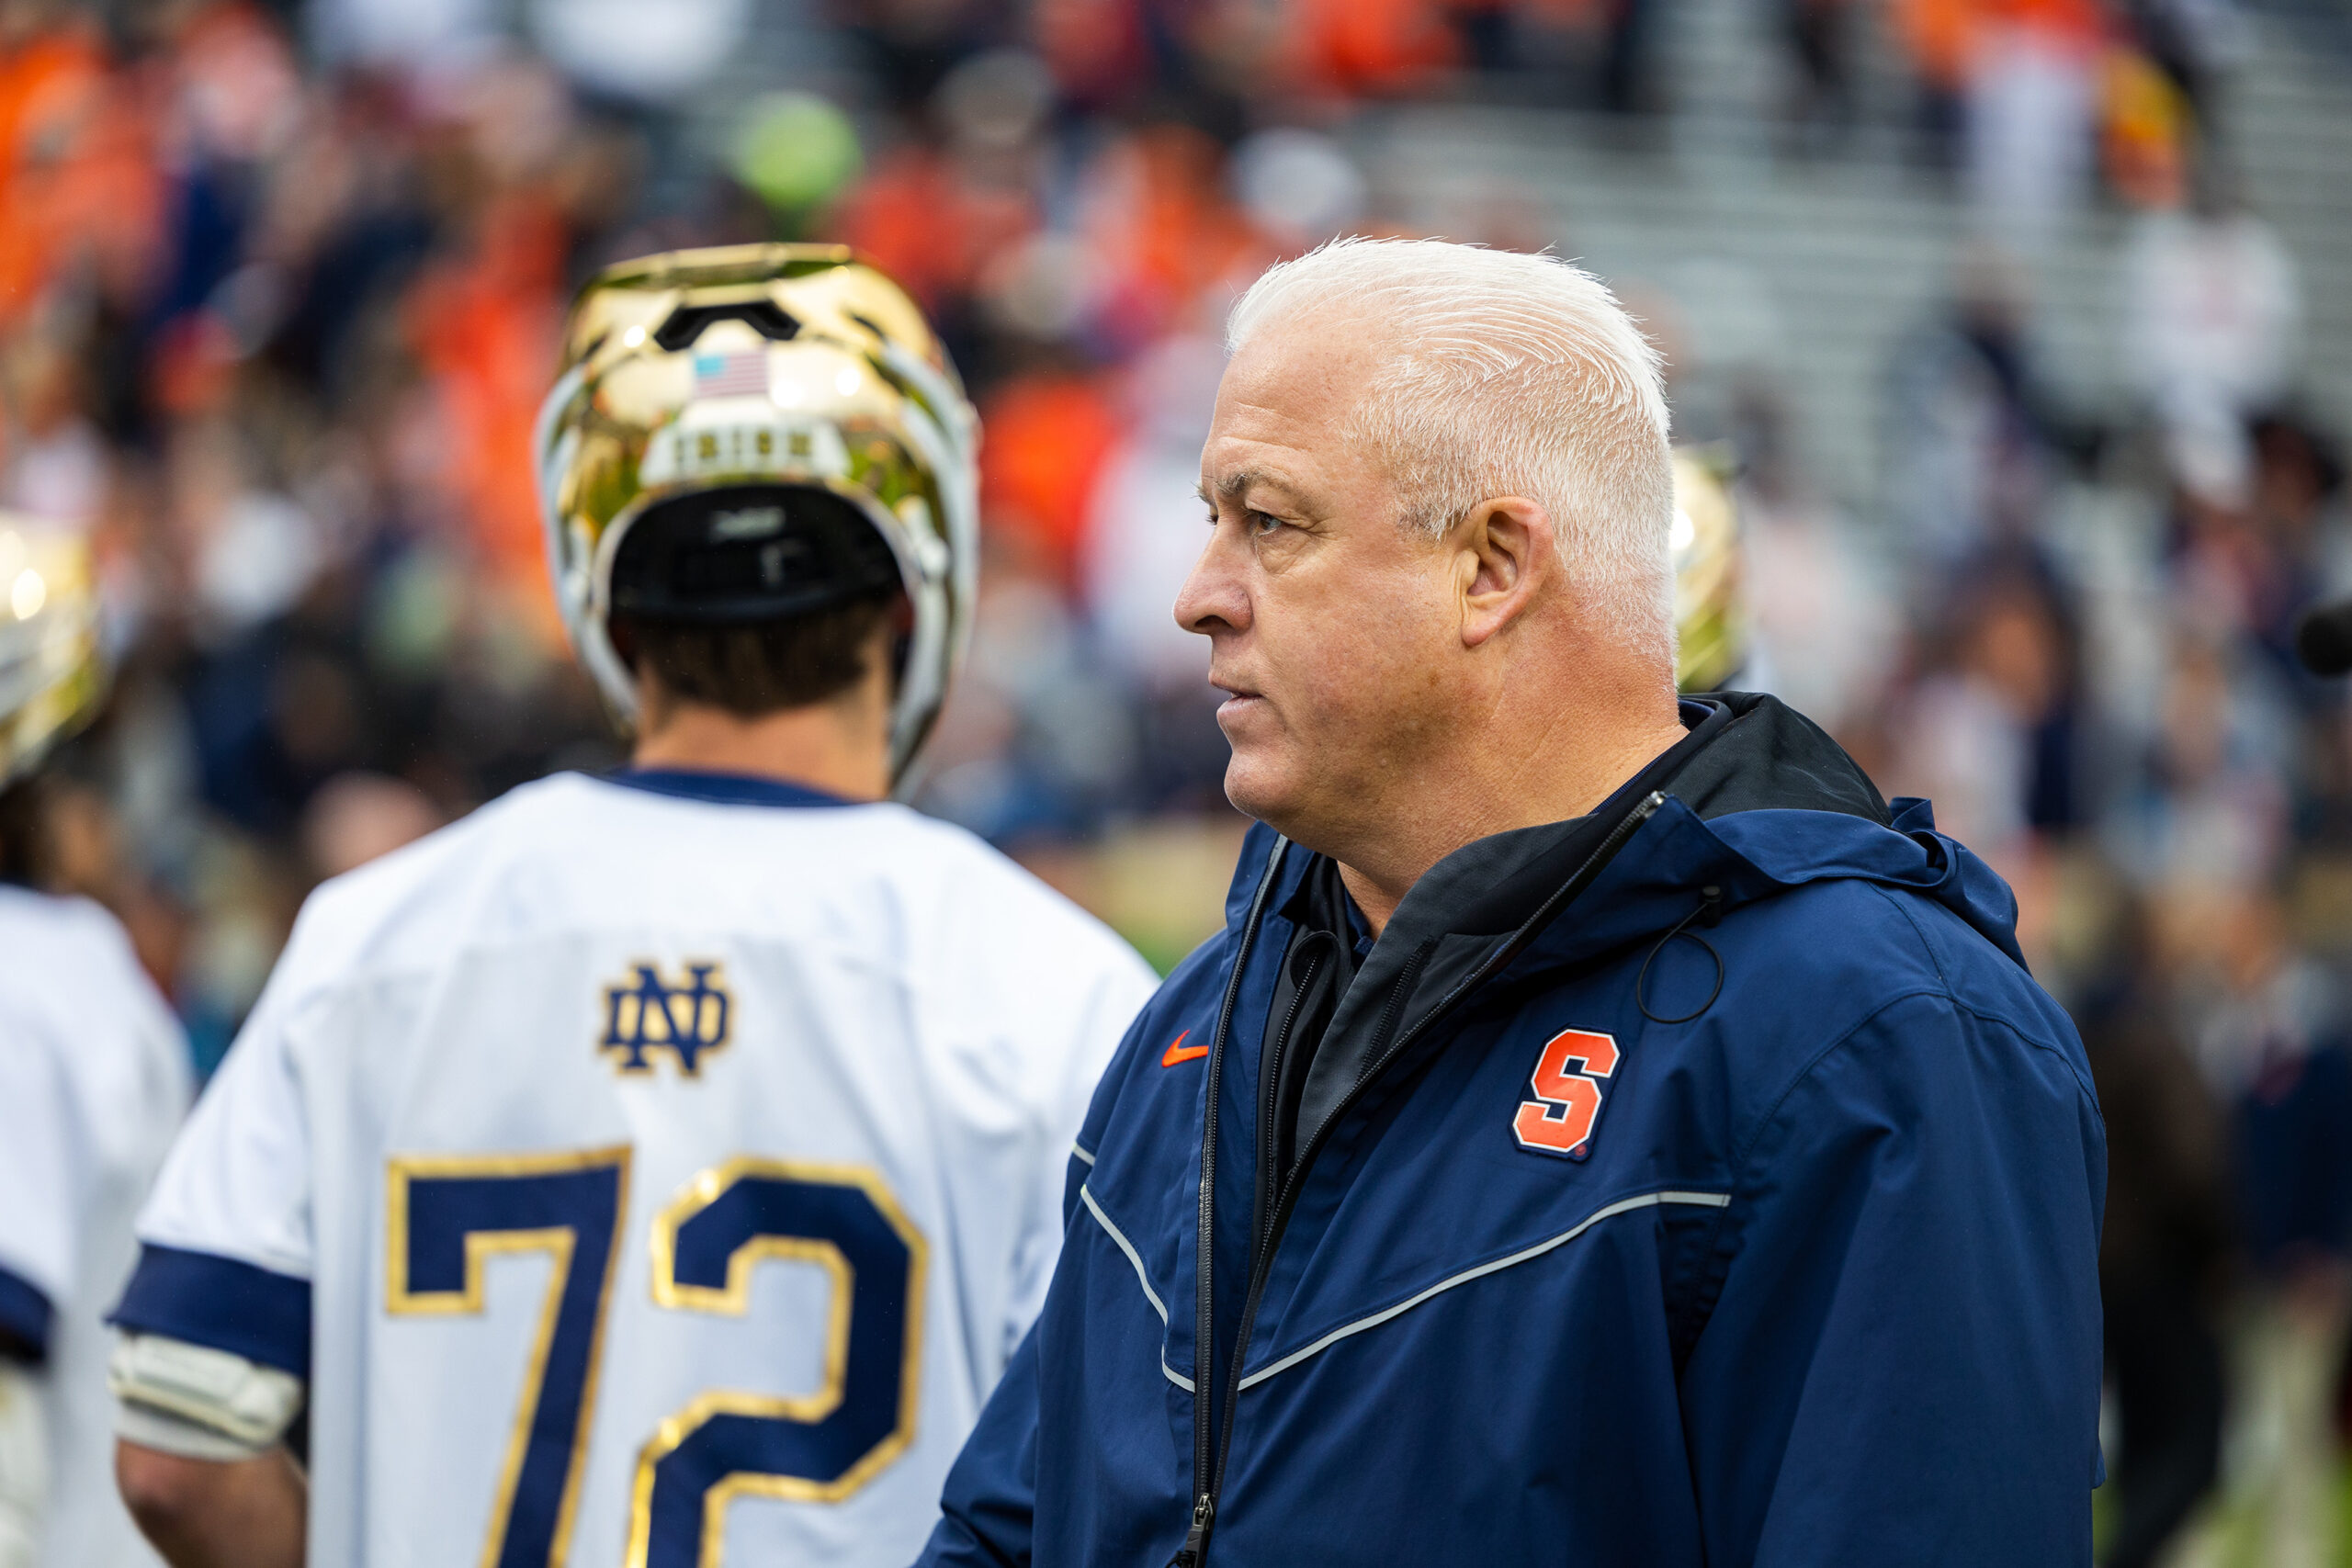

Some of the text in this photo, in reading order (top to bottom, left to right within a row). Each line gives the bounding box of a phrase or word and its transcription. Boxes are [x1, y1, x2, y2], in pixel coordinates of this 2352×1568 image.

[600, 961, 736, 1077] ND
[1512, 1028, 1621, 1154] S
[386, 1145, 929, 1568] 72
